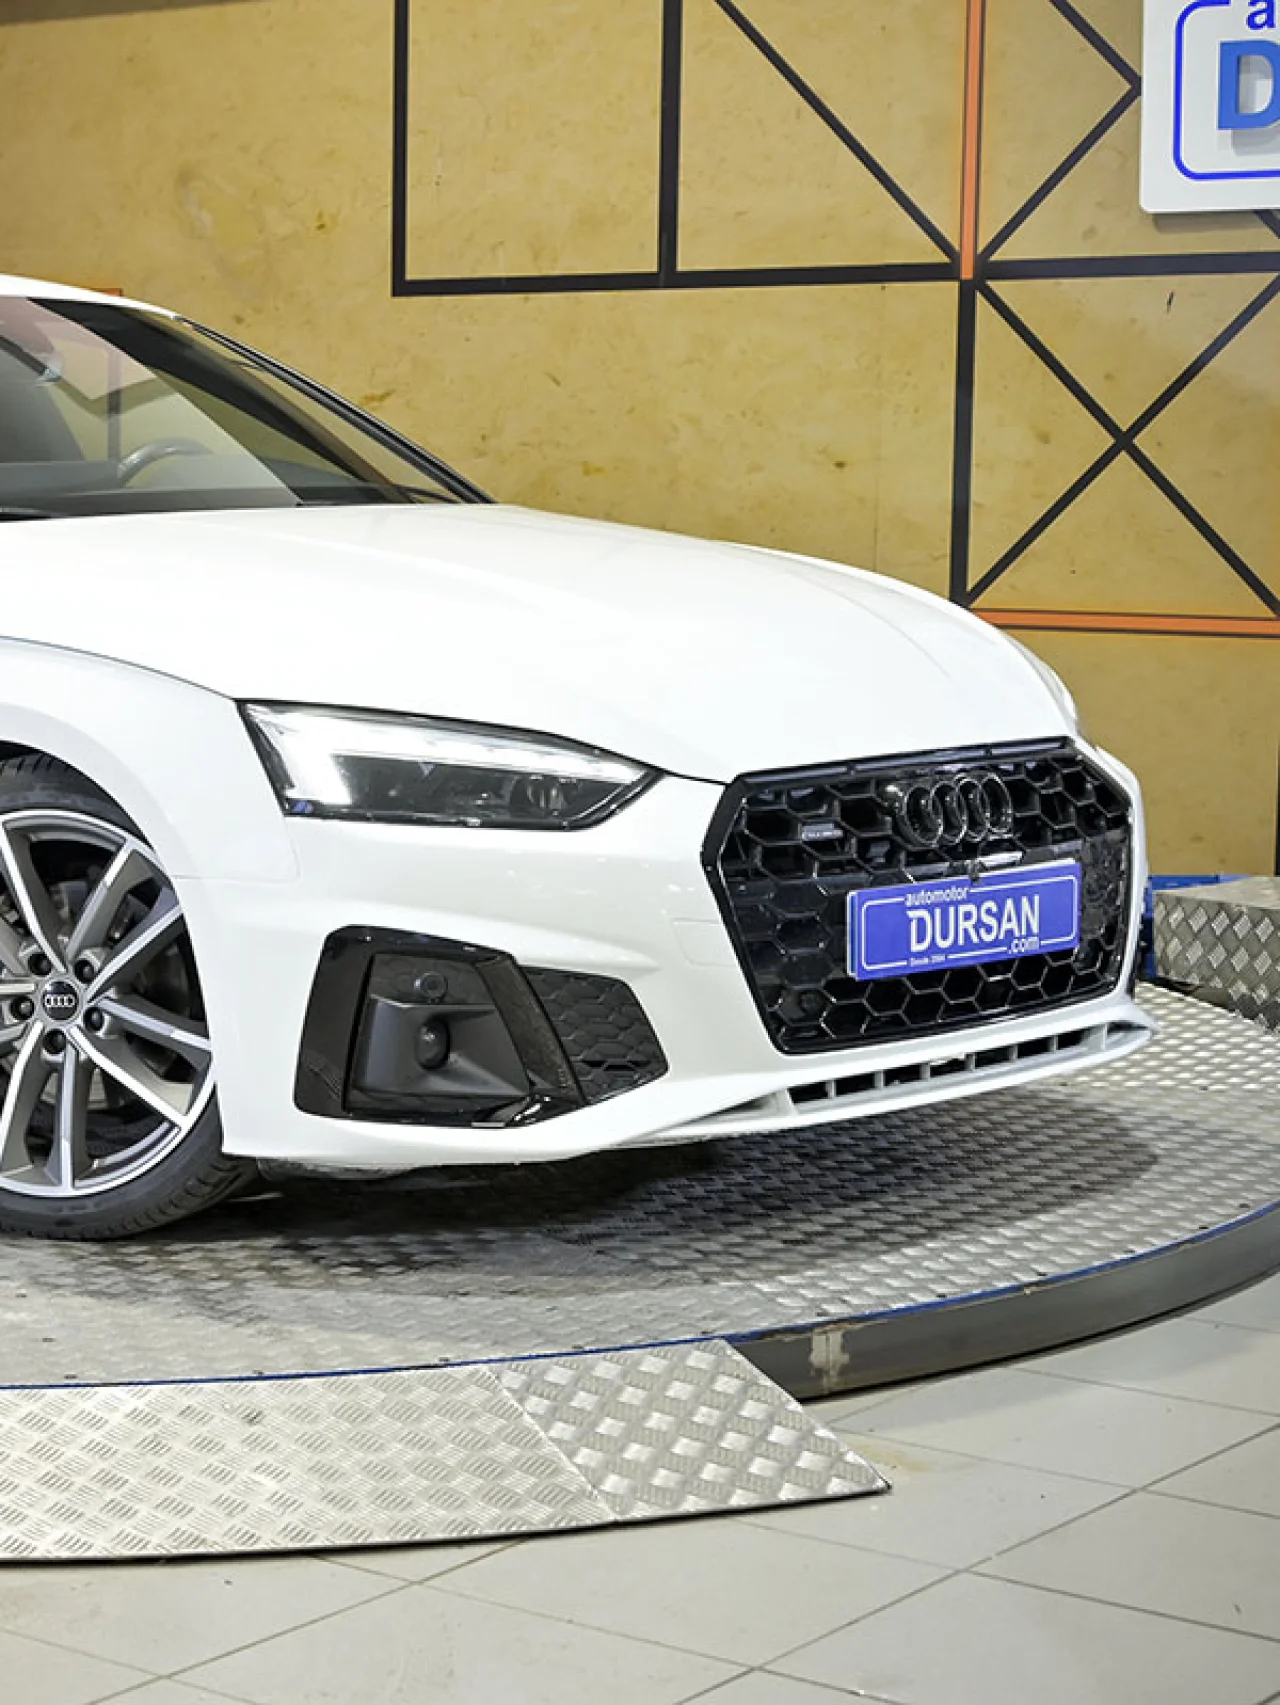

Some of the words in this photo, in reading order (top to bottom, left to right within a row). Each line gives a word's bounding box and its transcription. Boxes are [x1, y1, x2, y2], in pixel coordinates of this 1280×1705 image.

[1218, 40, 1280, 130] D
[906, 886, 968, 906] automotor
[906, 894, 1040, 953] DURSAN
[1007, 936, 1040, 954] .com
